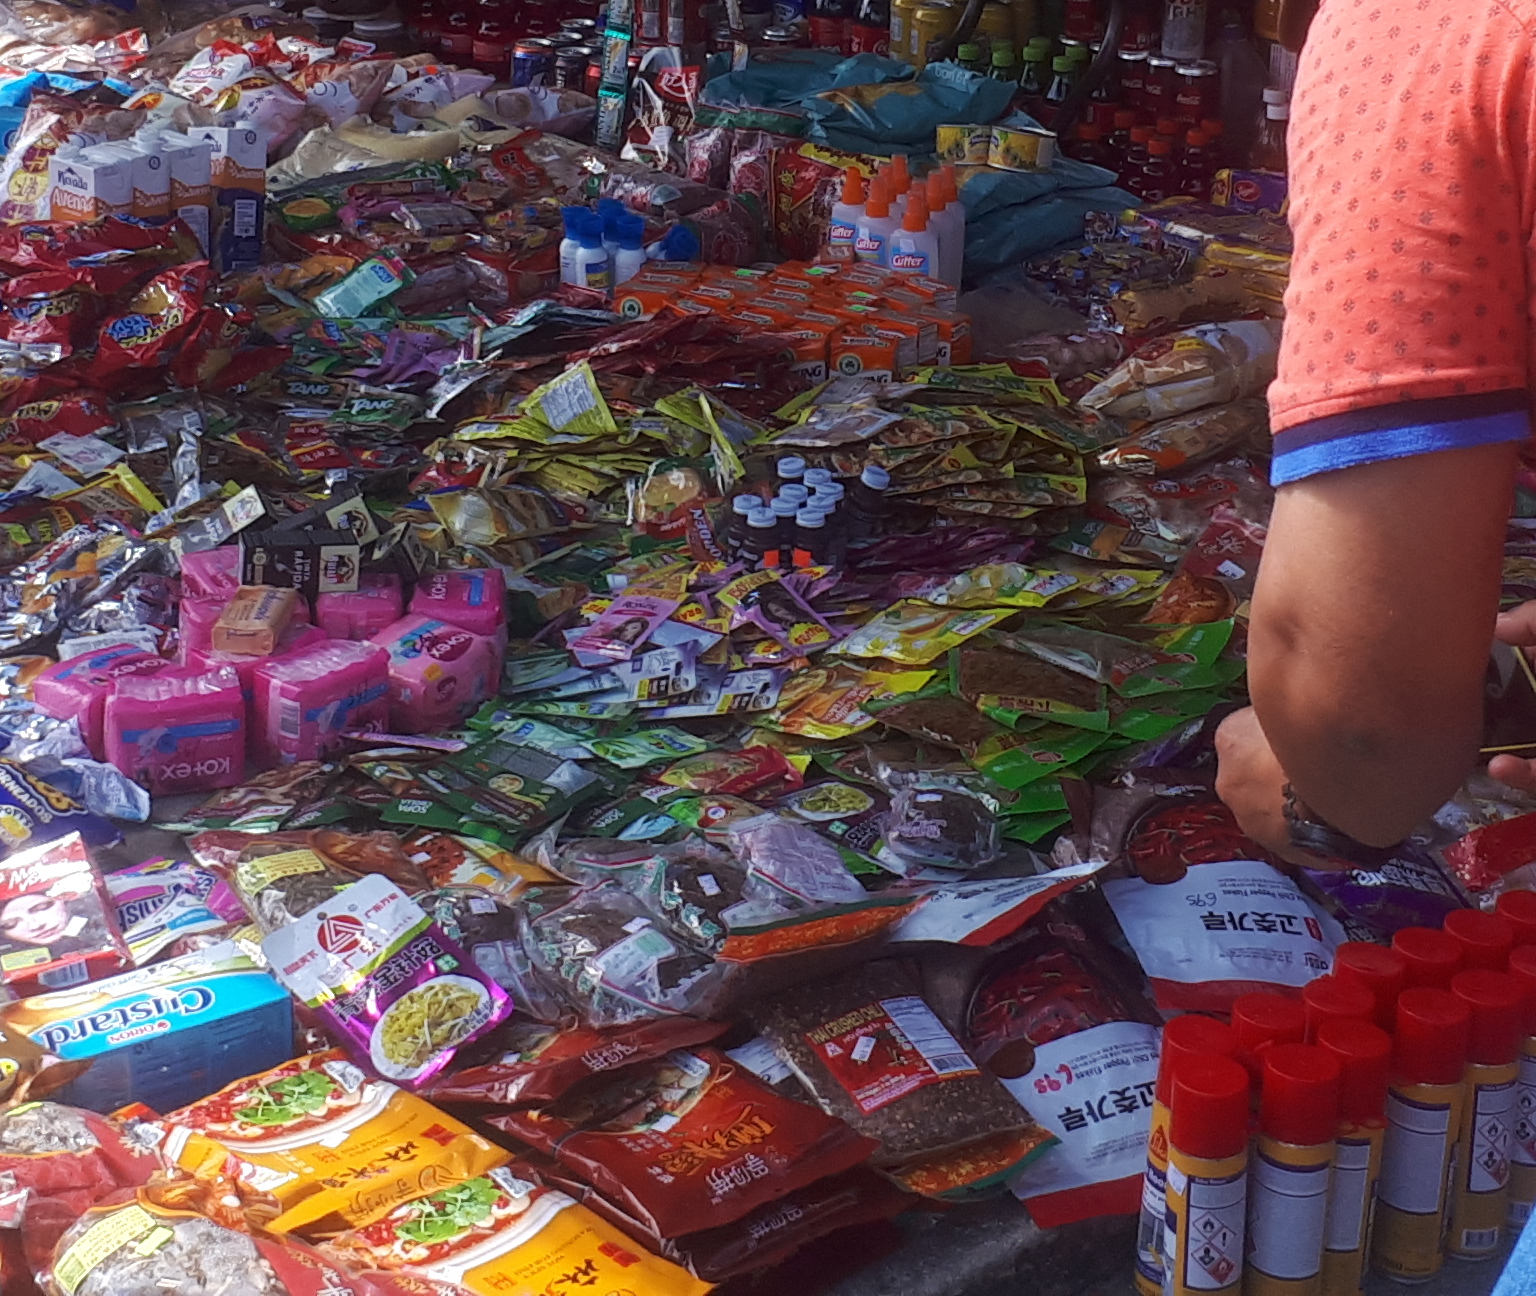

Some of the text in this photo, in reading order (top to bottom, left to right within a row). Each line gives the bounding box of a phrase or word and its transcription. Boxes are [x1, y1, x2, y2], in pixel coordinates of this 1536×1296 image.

[891, 255, 925, 266] Cutter
[286, 382, 331, 396] TANG
[345, 398, 395, 415] TANG
[1199, 910, 1303, 936] 고춧가루
[43, 986, 216, 1052] Custard
[109, 1024, 155, 1043] ORION
